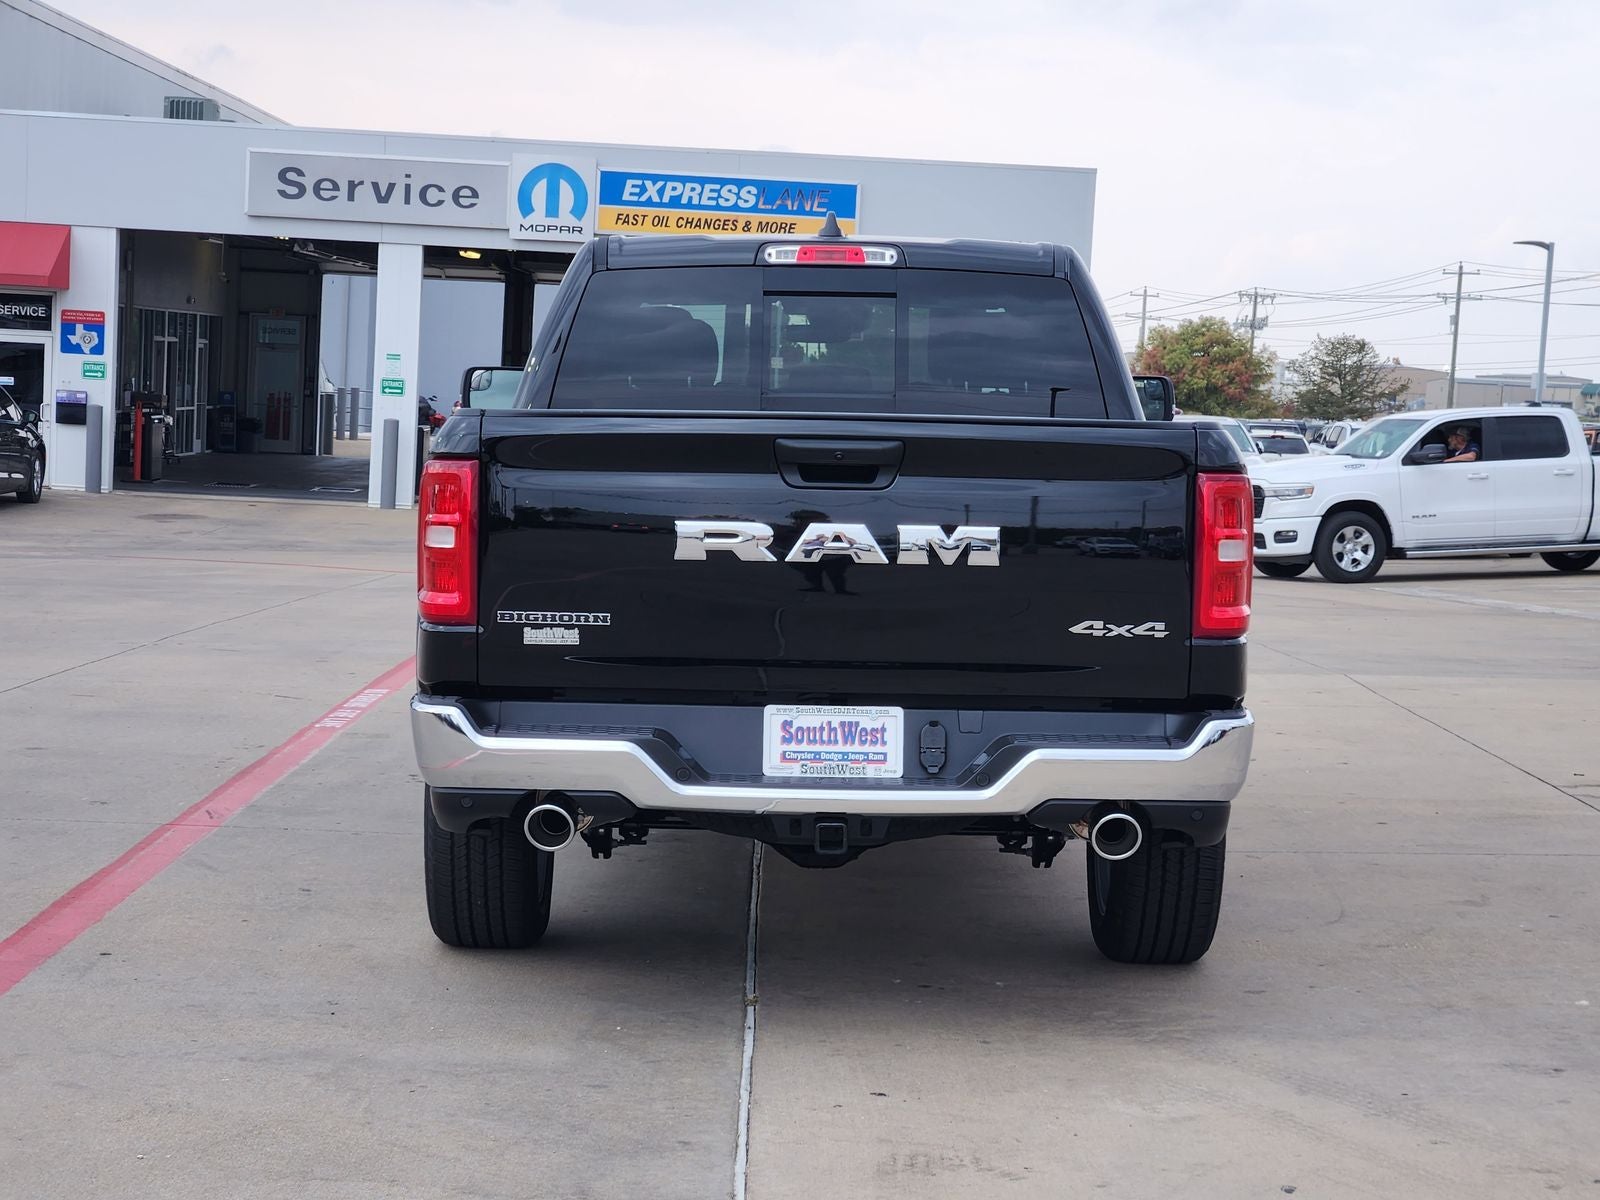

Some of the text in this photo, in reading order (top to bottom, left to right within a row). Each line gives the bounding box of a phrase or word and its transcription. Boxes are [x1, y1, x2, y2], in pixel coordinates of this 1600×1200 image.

[276, 166, 480, 209] Service
[621, 178, 832, 213] EXPRESSLANE
[519, 223, 583, 235] MOPAR
[615, 213, 797, 235] FAST OIL CHANGES & MORE
[84, 363, 104, 371] ENTRANCE
[383, 380, 403, 388] ENTRANCE
[674, 520, 1001, 566] RAM
[497, 611, 611, 625] BIGHORN
[523, 627, 580, 639] SouthWest
[1068, 620, 1170, 638] 4x4
[780, 719, 888, 748] SouthWest
[785, 751, 885, 762] Chrysler Dodge Jeep Ram
[800, 764, 868, 776] SouthWest
